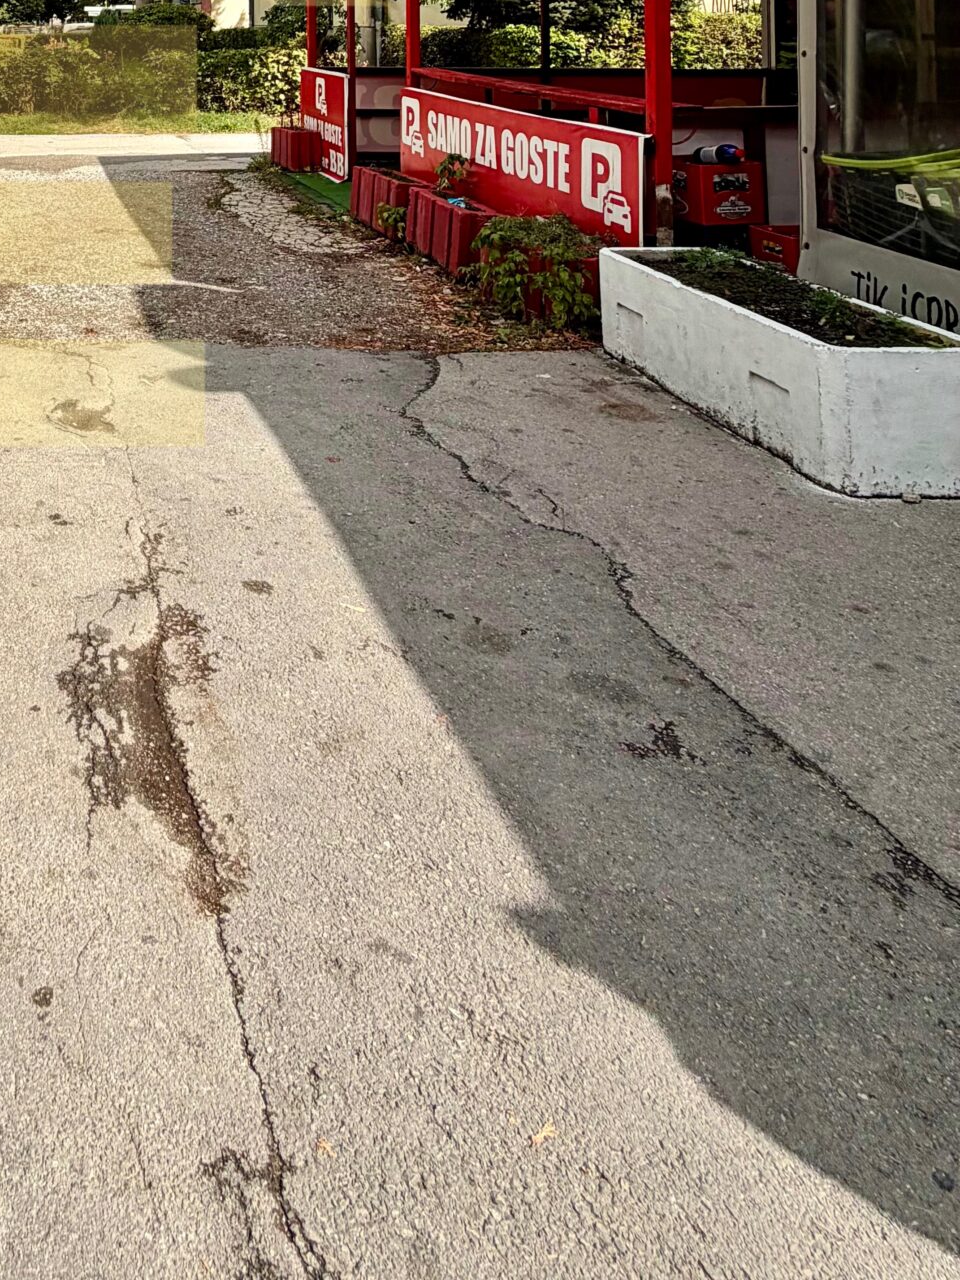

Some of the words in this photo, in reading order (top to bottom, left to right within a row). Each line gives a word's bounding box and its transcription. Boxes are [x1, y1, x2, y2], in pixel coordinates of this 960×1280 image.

[324, 122, 342, 147] GOSTE
[329, 148, 344, 177] BB
[427, 109, 471, 159] SAMO
[475, 122, 498, 170] ZA
[501, 129, 571, 194] GOSTE
